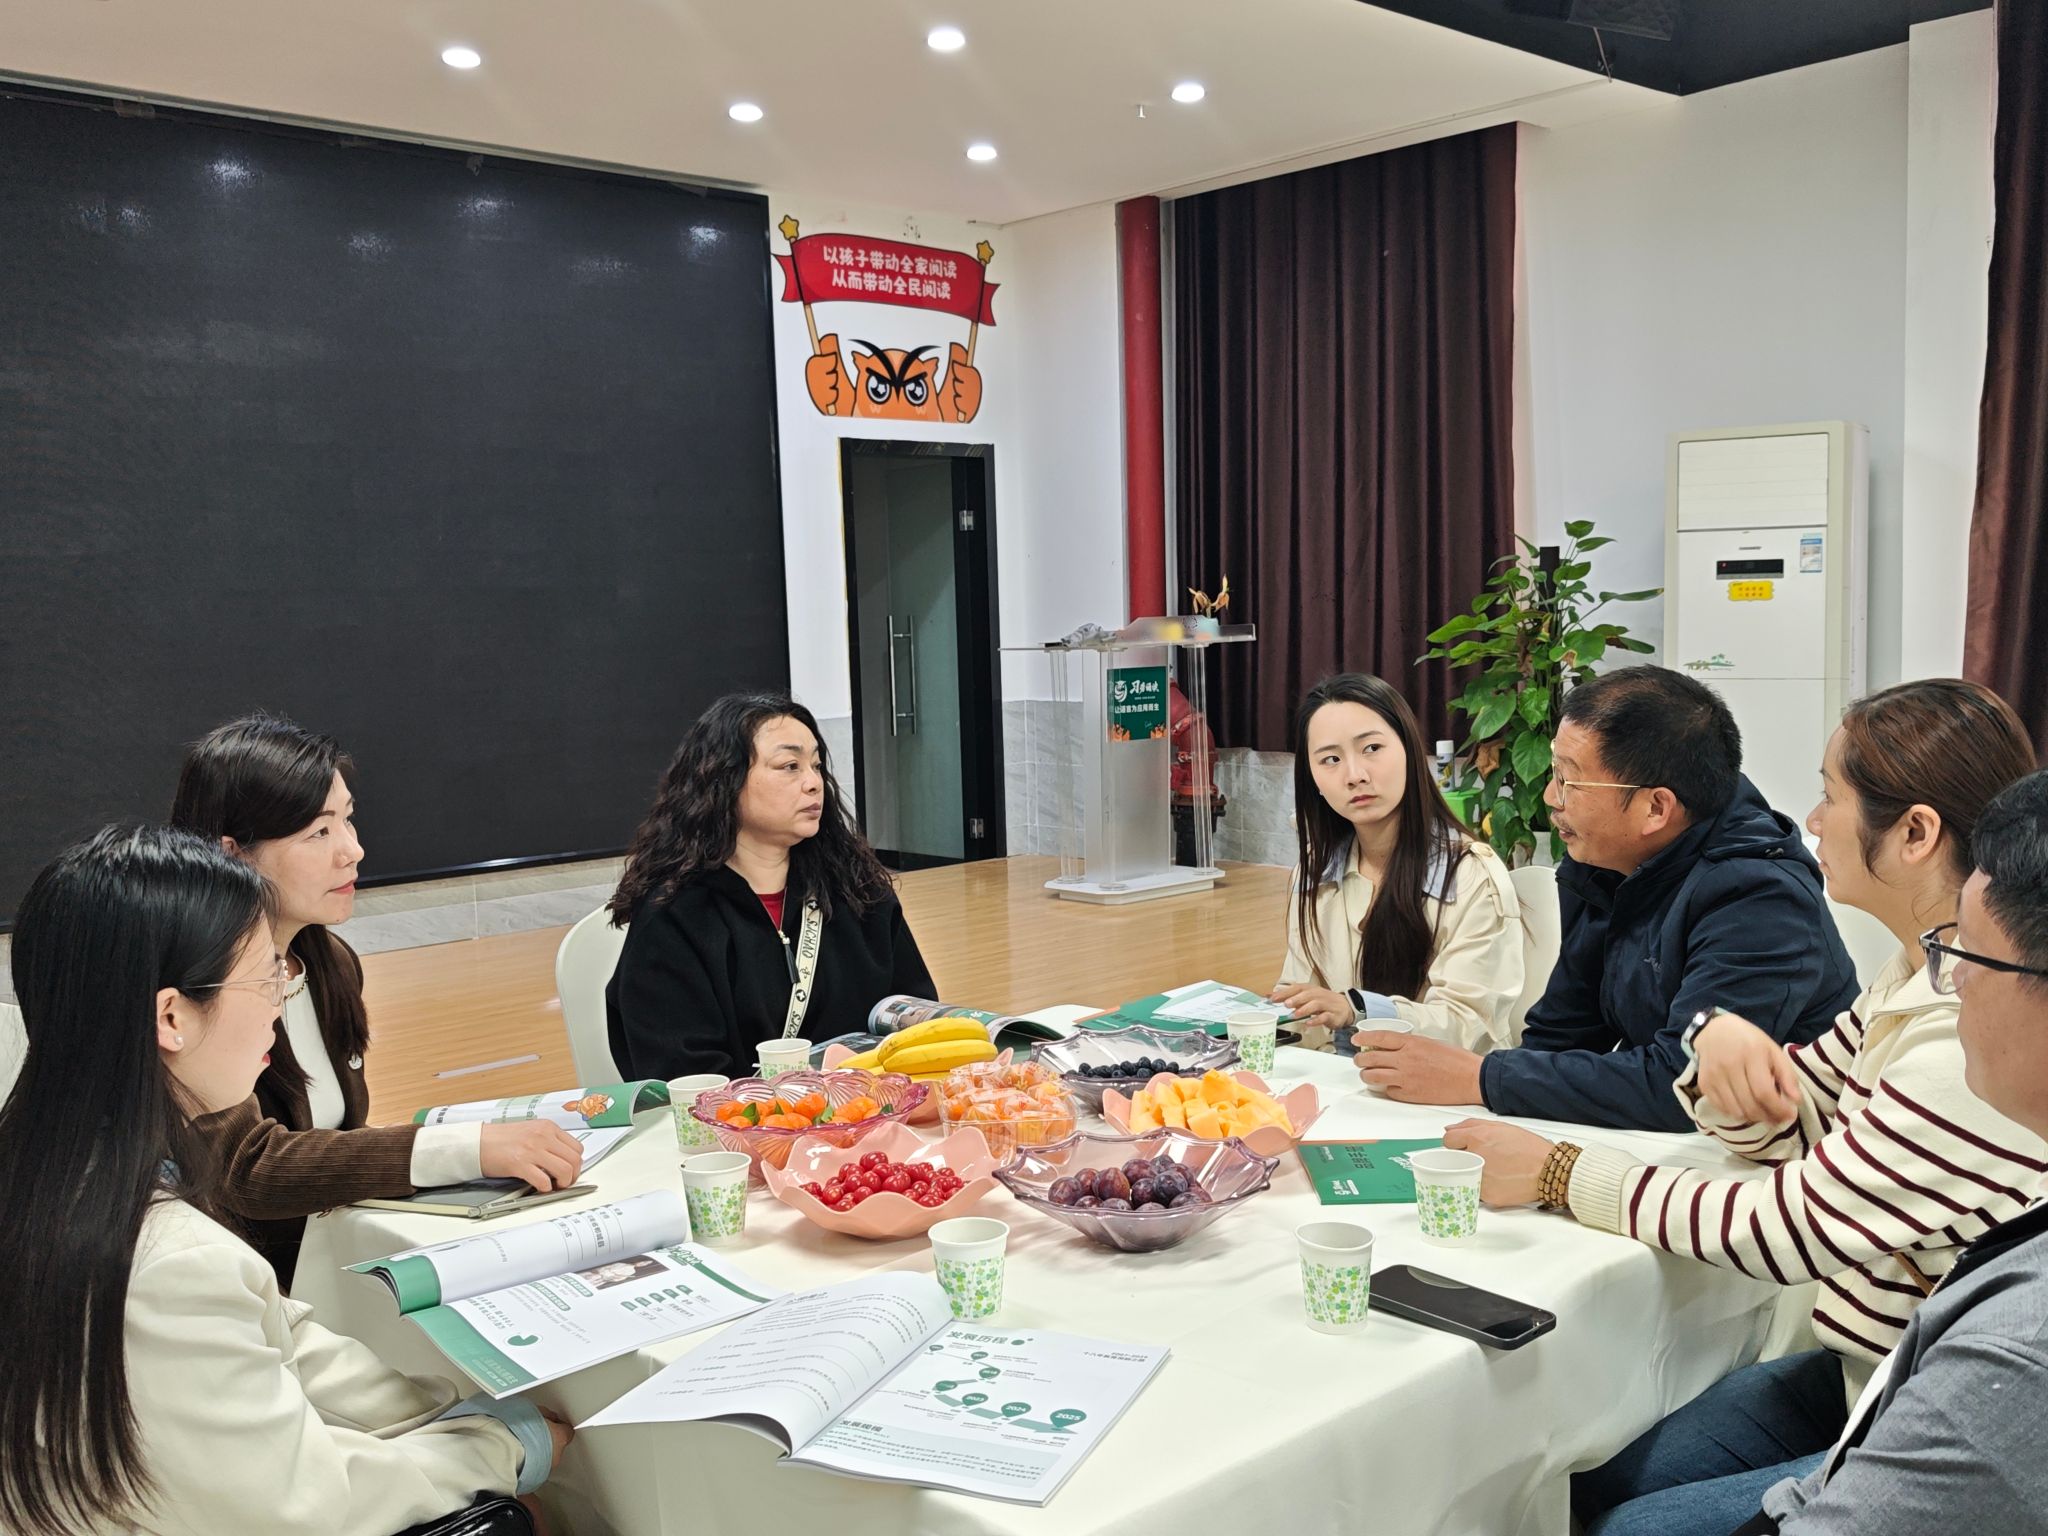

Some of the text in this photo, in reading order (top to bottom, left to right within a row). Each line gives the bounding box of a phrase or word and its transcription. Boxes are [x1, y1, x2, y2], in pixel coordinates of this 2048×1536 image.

[823, 245, 958, 280] 以孩子带动全家阅读
[832, 268, 952, 300] 从而带动全民阅读
[946, 1330, 1008, 1345] 发展历程
[1006, 1404, 1027, 1413] 2024
[1055, 1412, 1082, 1422] 2025
